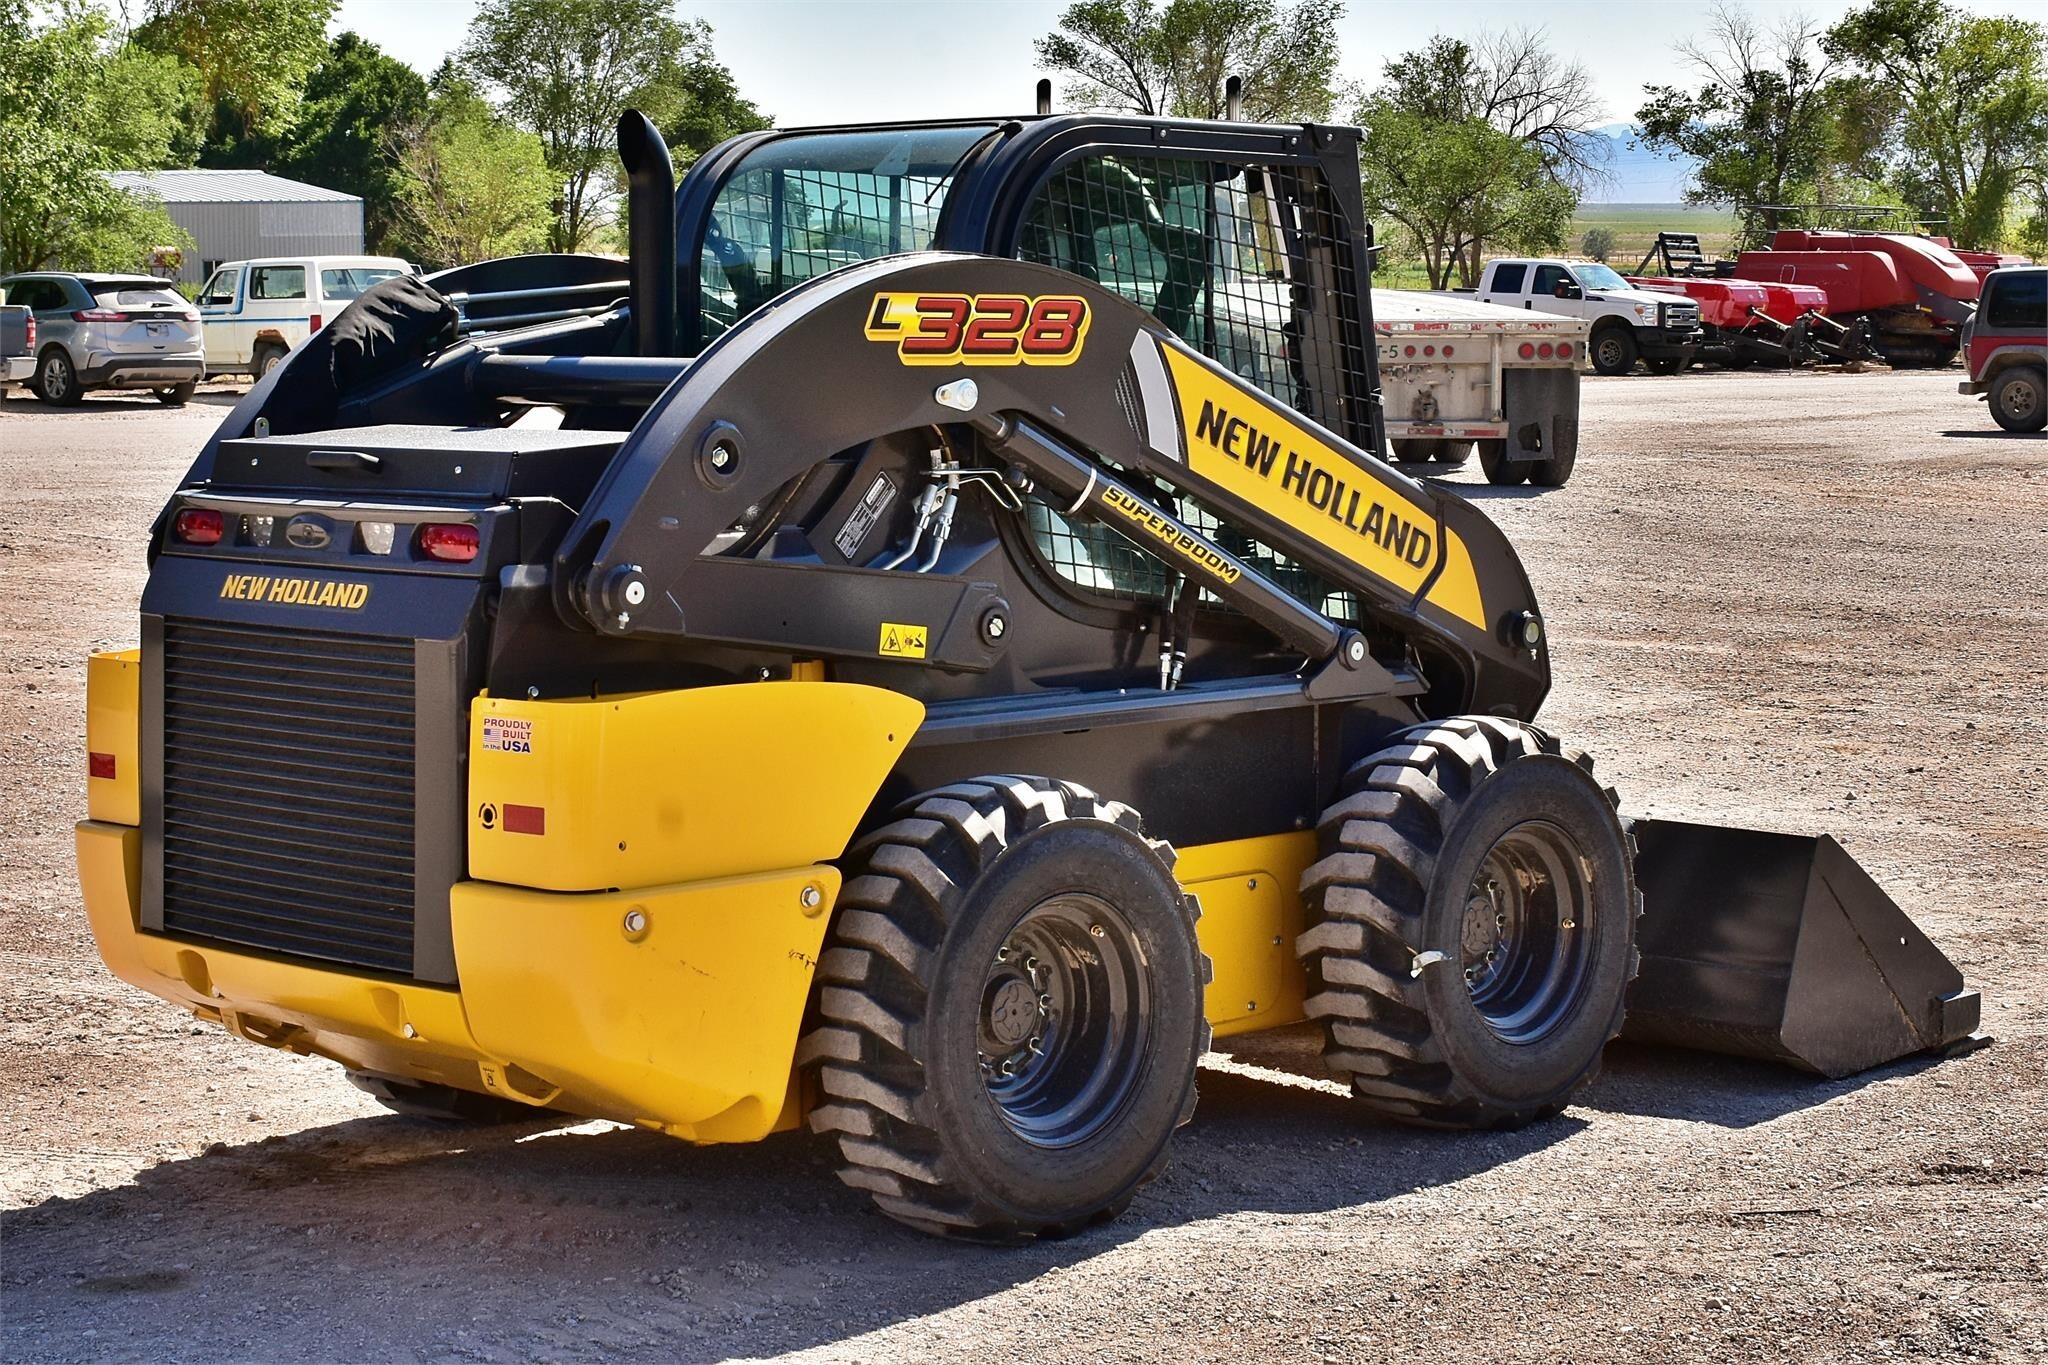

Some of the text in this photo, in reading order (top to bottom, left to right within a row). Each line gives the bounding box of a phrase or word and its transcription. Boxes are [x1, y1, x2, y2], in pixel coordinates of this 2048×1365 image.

[866, 295, 1090, 359] L328
[1196, 400, 1432, 569] NEW HOLLAND
[1104, 487, 1239, 581] SUPER BOOM
[220, 574, 369, 609] NEW HOLLAND
[483, 718, 532, 730] PROUDLY
[502, 729, 532, 740] BUILT
[502, 740, 531, 753] USA
